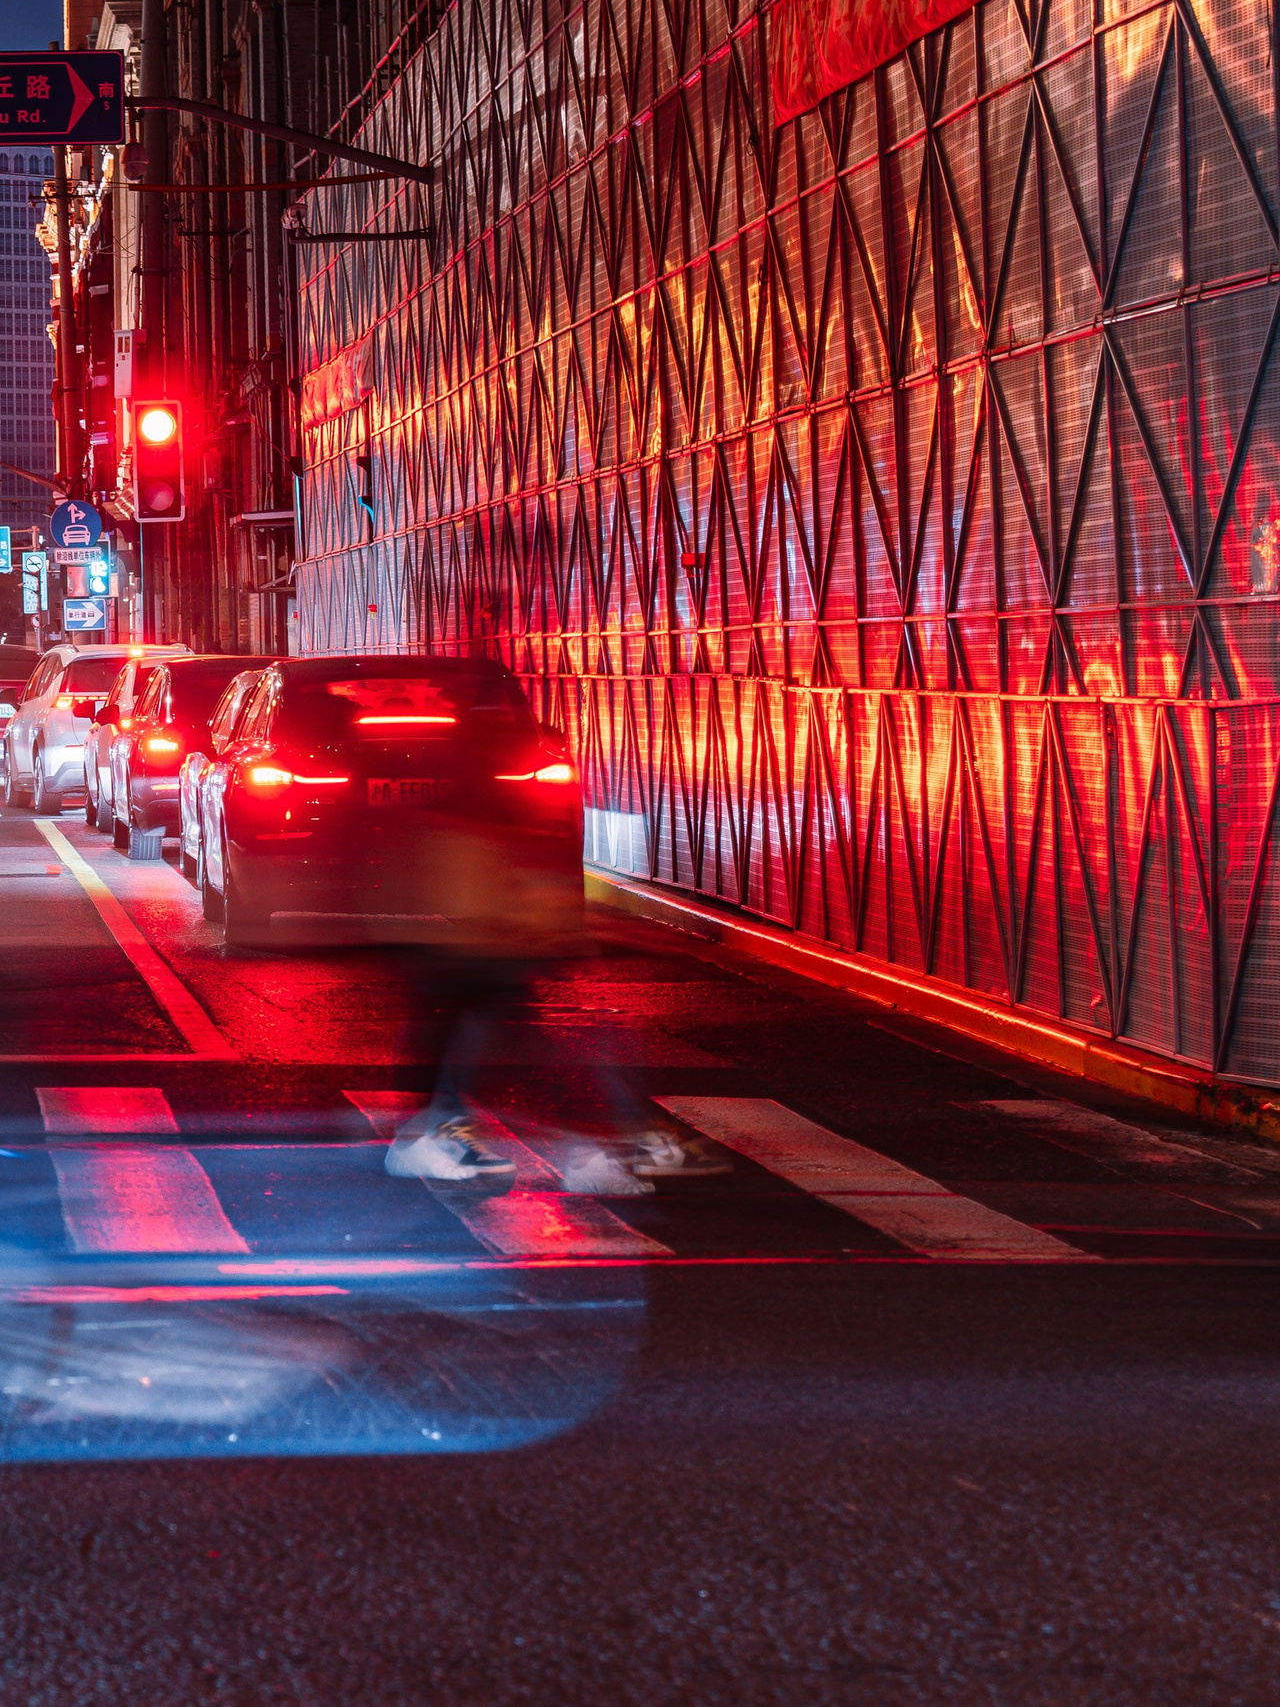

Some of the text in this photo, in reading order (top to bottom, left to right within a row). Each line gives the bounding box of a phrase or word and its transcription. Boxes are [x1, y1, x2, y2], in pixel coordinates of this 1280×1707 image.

[98, 81, 115, 99] 南
[104, 100, 111, 111] S
[16, 109, 47, 124] Rd.
